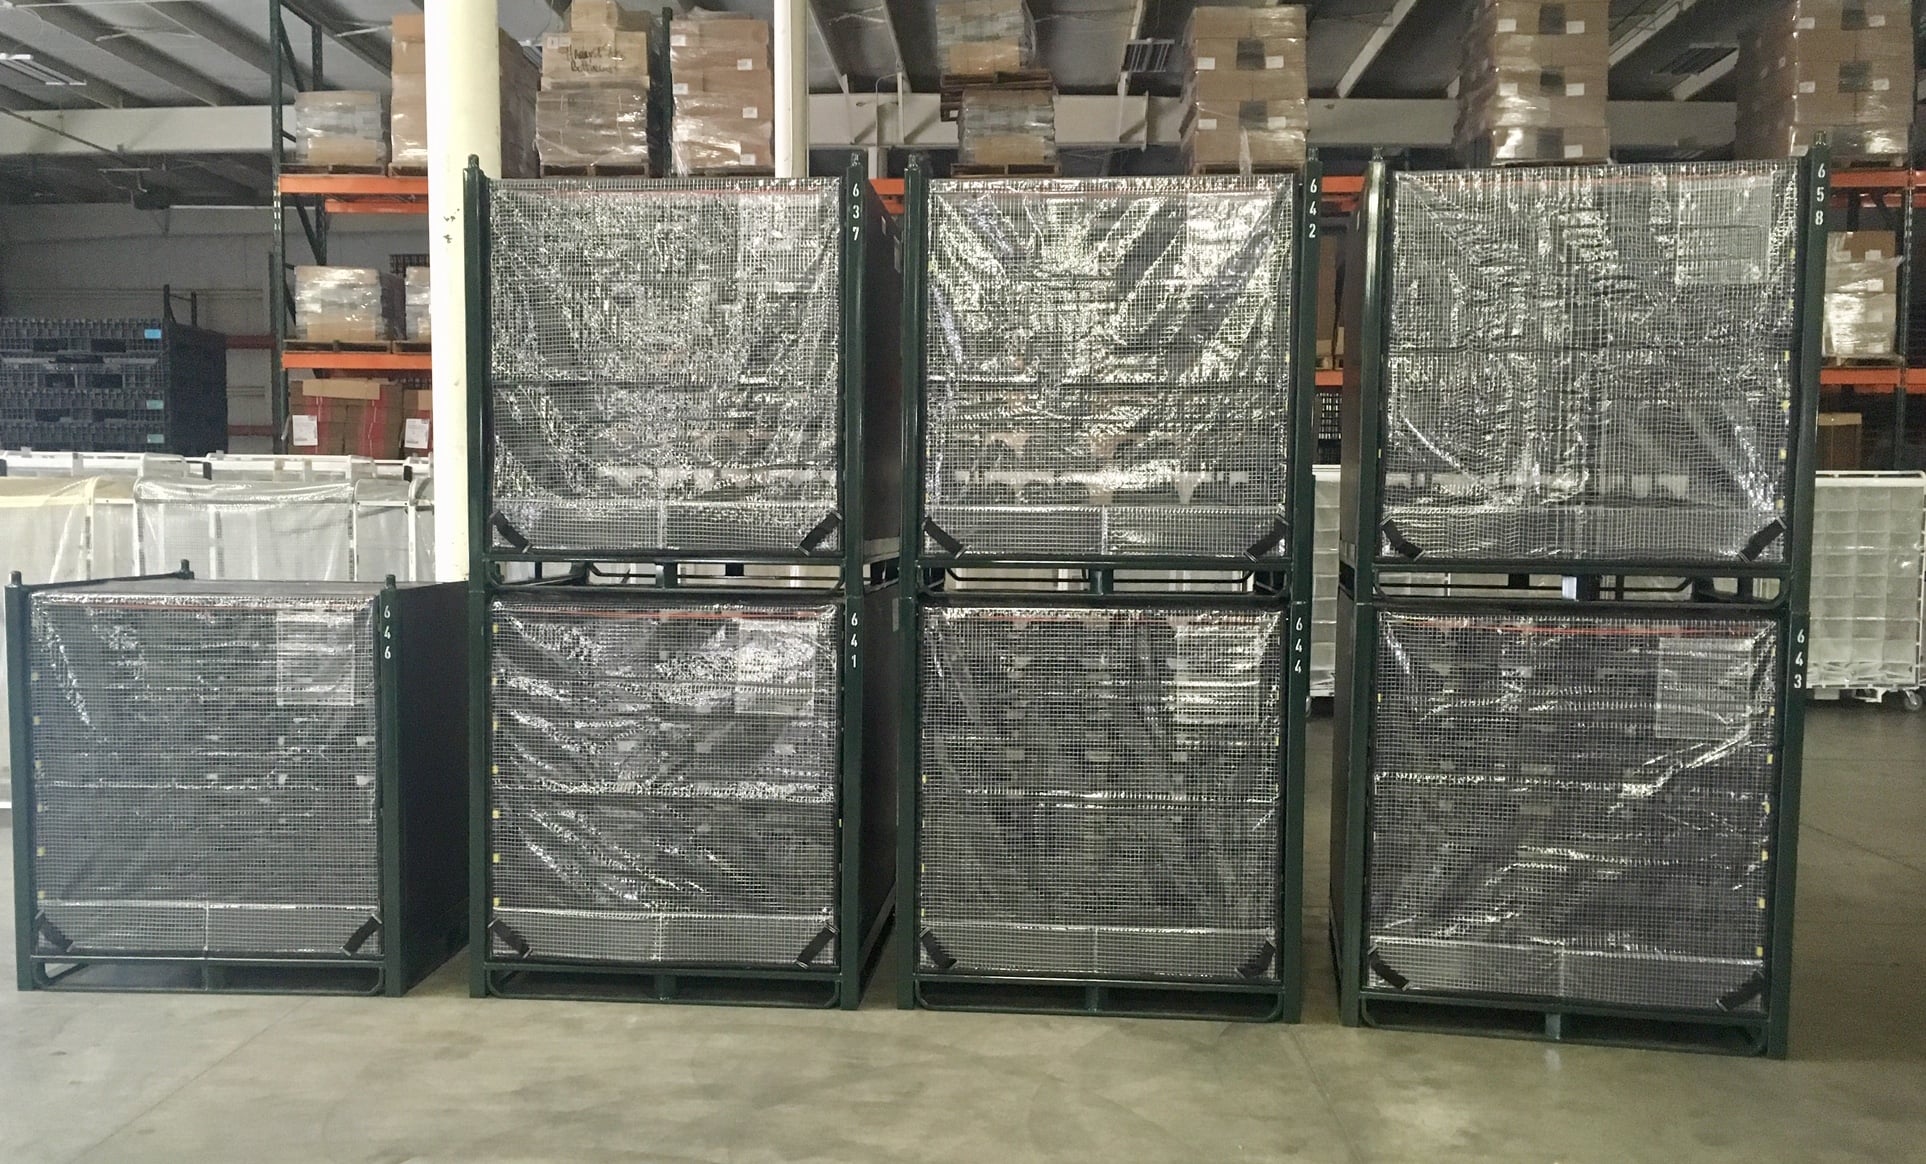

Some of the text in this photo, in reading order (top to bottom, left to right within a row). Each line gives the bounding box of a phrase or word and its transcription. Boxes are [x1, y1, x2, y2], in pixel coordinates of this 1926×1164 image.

[852, 183, 860, 241] 637
[1309, 178, 1318, 239] 642
[1814, 163, 1826, 226] 658
[383, 605, 392, 660] 646
[850, 612, 859, 669] 641
[1294, 616, 1303, 674] 644
[1794, 628, 1806, 689] 643
